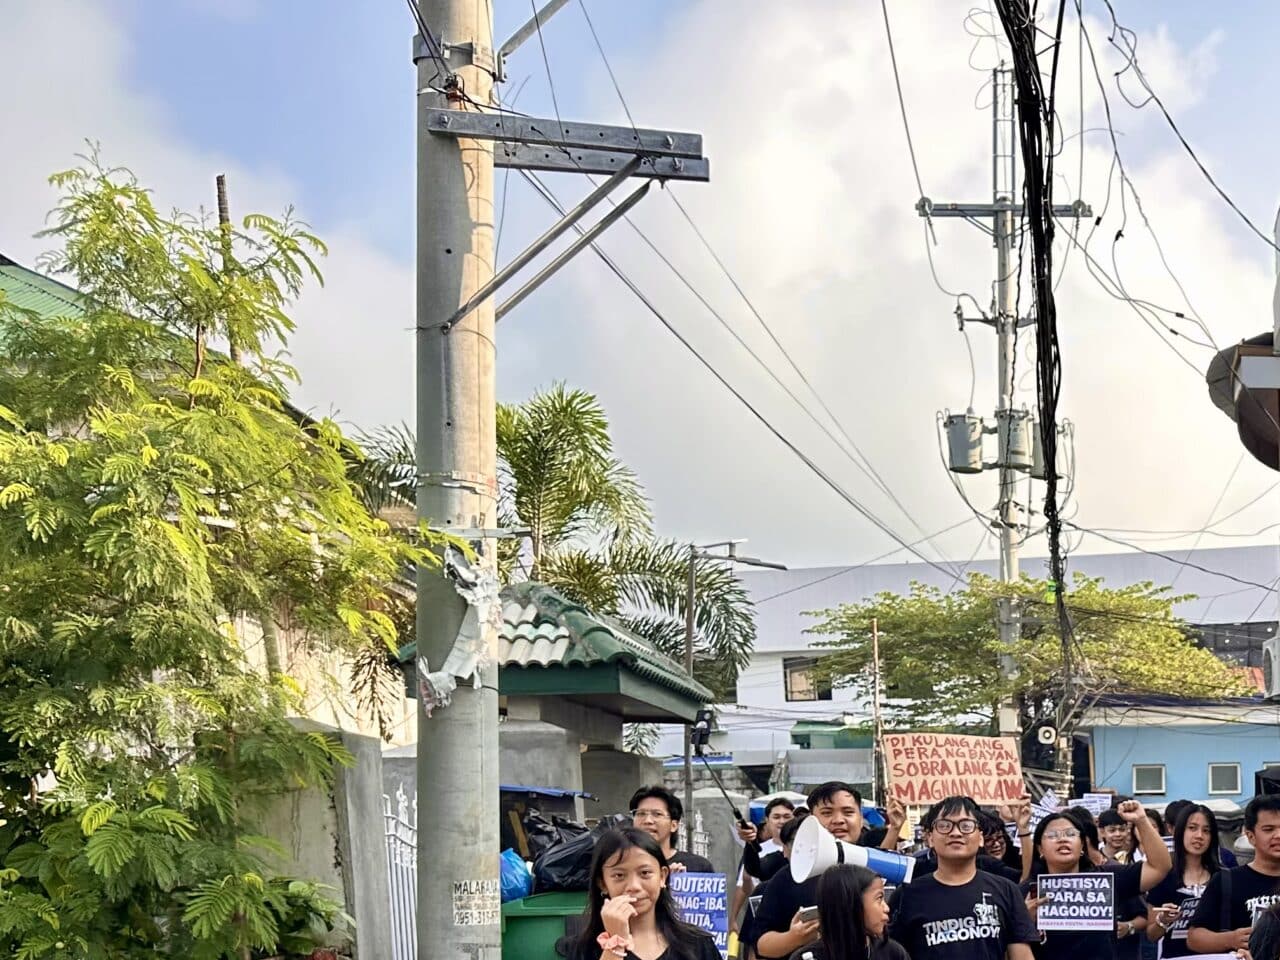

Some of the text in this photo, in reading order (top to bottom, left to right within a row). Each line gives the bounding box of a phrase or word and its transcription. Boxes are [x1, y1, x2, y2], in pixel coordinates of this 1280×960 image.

[912, 735, 970, 748] KULANG
[974, 738, 1004, 750] ANG
[892, 747, 940, 760] PERA
[945, 748, 966, 759] NG
[893, 760, 1017, 777] SOBRA LANG SA
[1041, 877, 1110, 889] HUSTISYA
[1046, 892, 1106, 902] PARA SA
[1039, 905, 1112, 917] HAGONOY!
[922, 916, 976, 935] TINDIG
